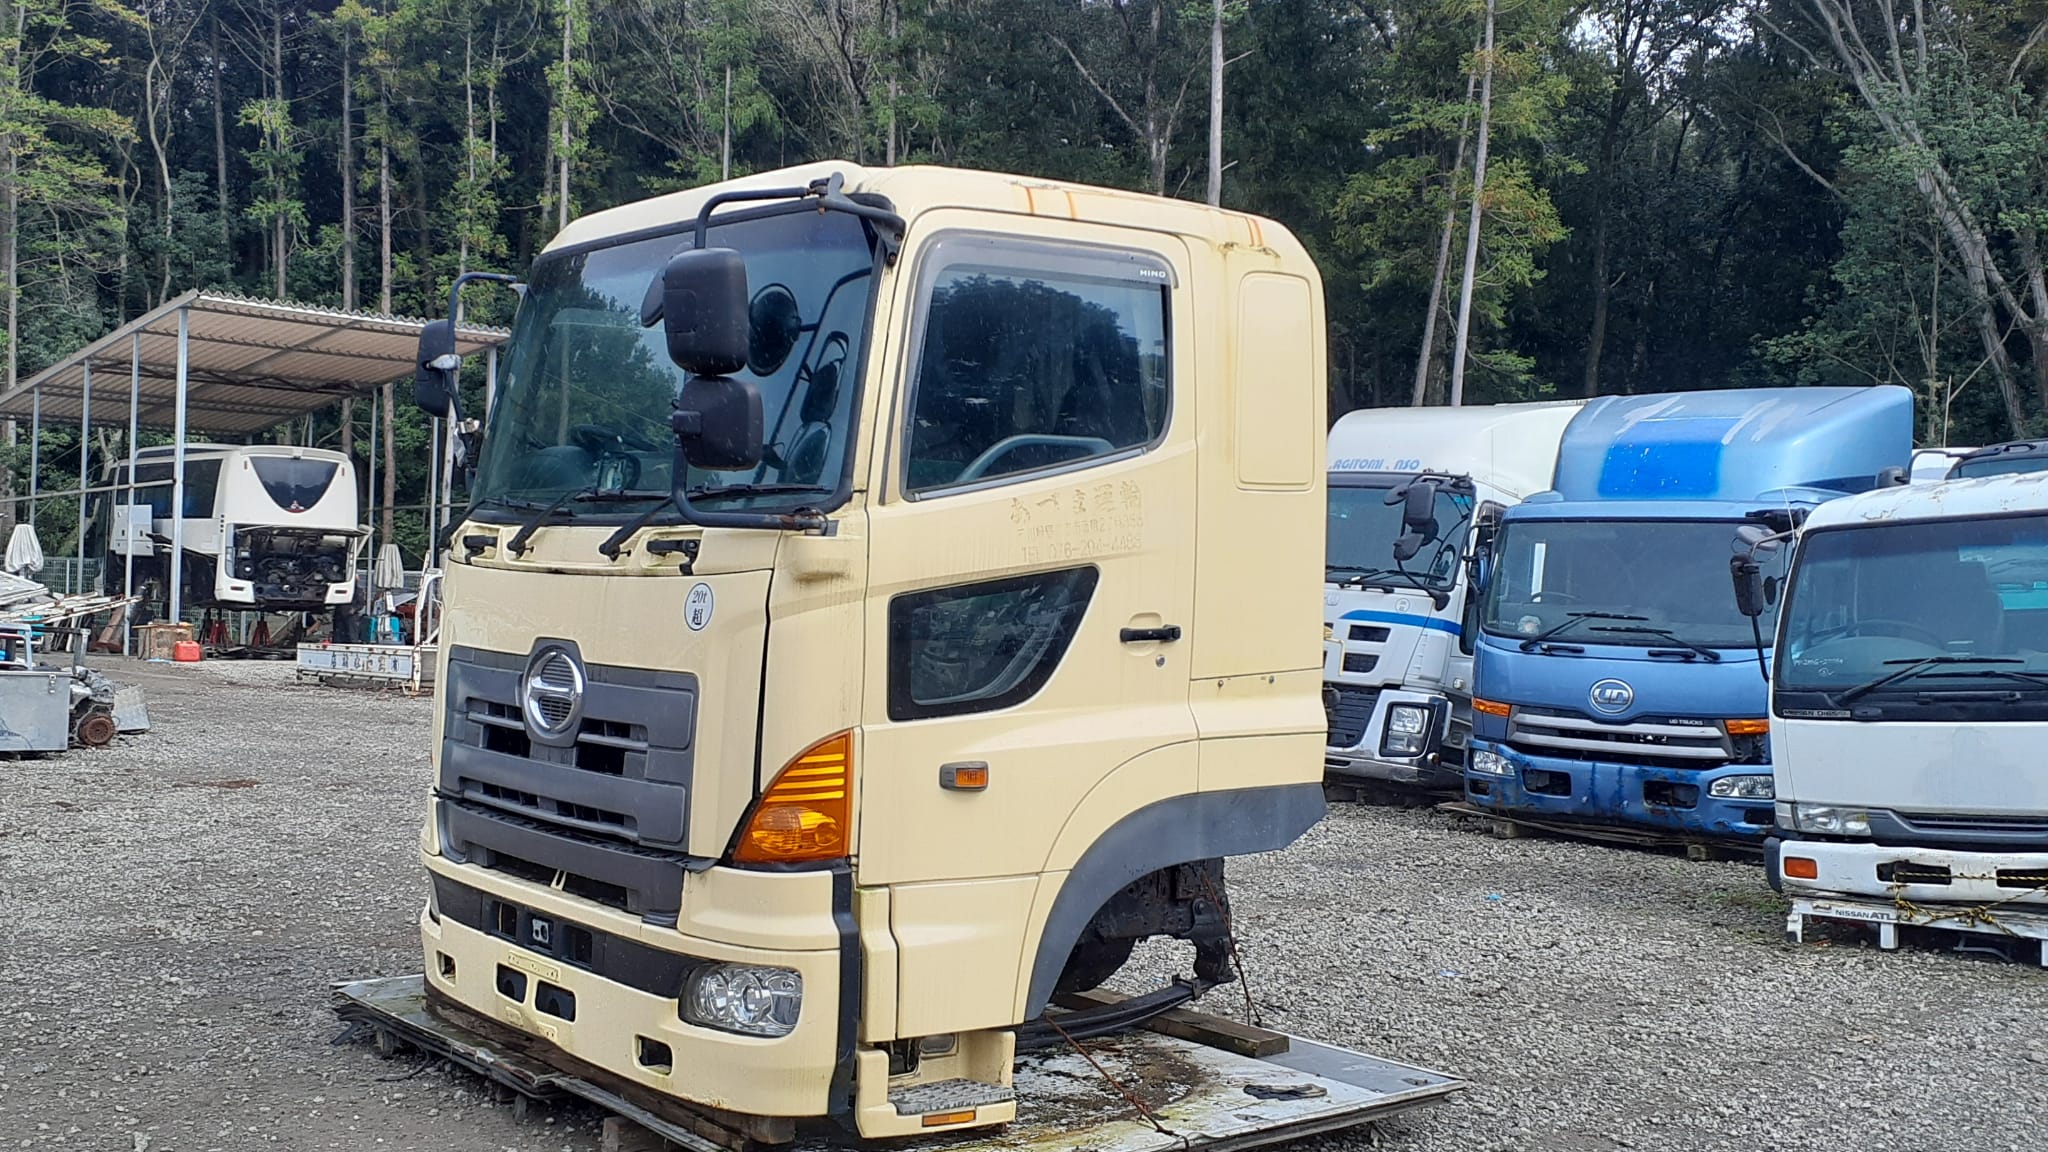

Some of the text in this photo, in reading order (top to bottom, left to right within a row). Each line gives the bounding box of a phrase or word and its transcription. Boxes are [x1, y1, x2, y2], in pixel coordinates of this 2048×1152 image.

[1139, 269, 1166, 279] HINO
[692, 590, 707, 603] 20t
[1593, 688, 1629, 704] UD
[1835, 909, 1869, 919] NISSAN
